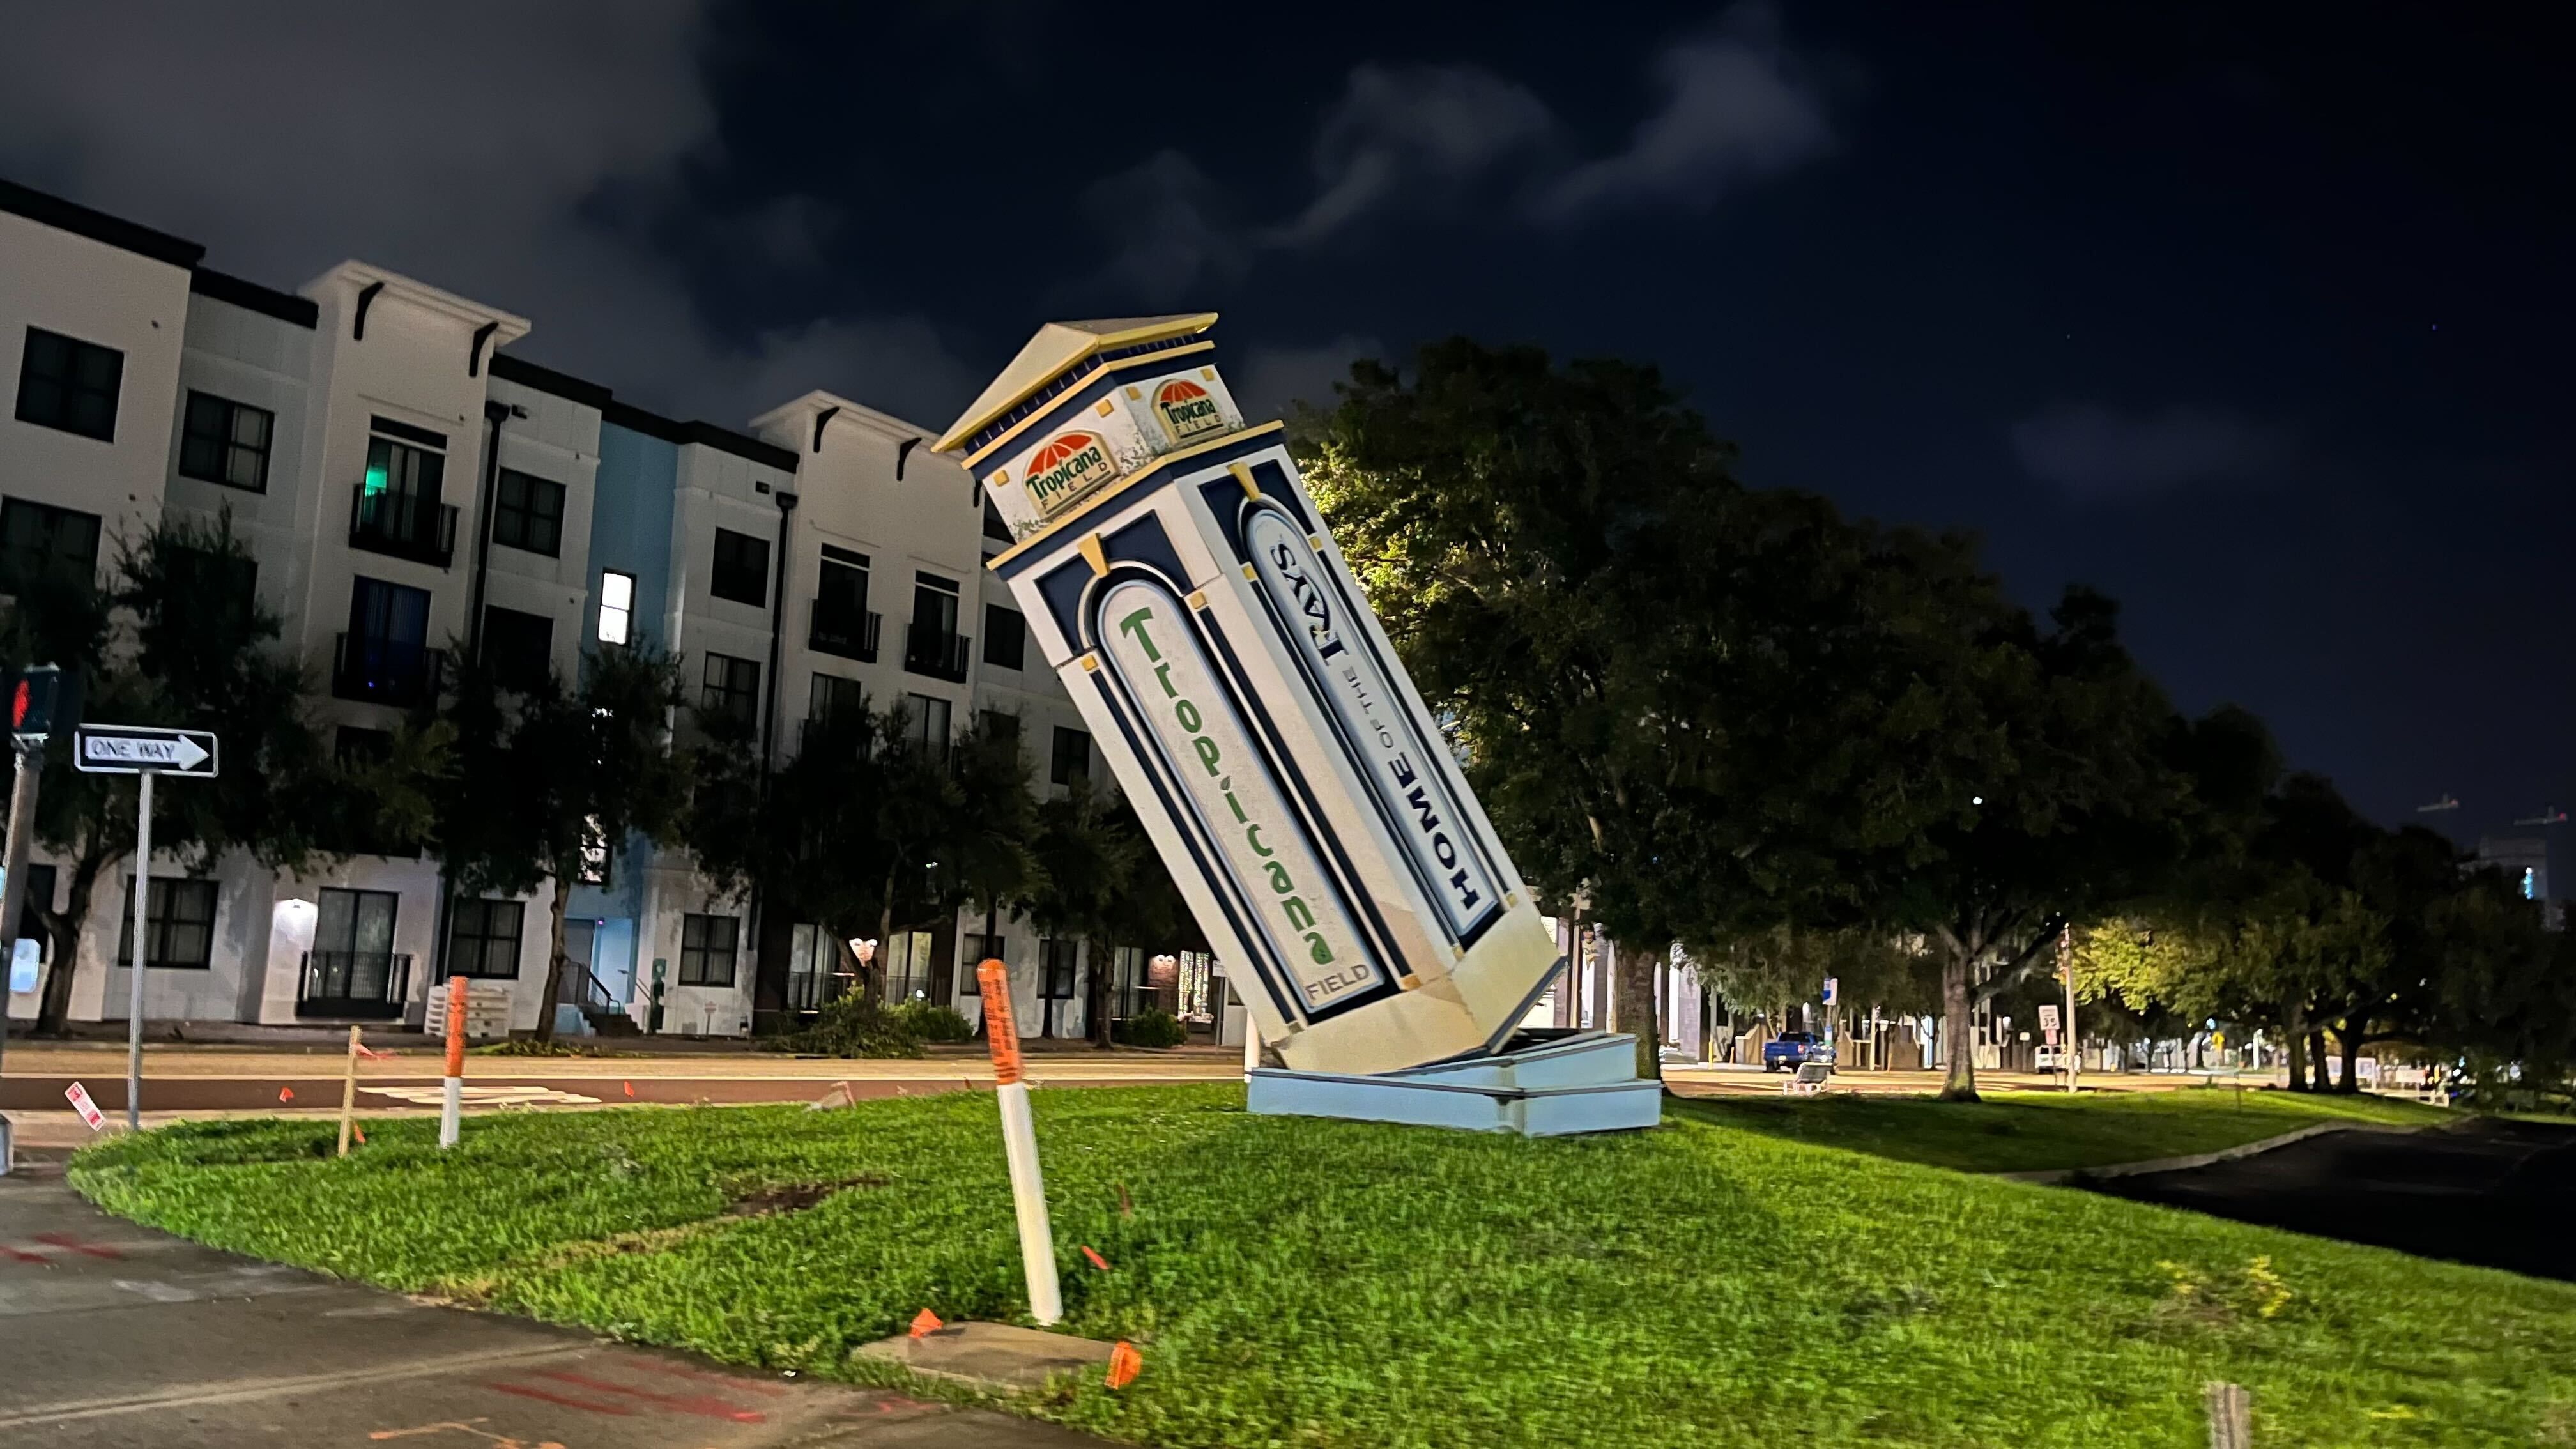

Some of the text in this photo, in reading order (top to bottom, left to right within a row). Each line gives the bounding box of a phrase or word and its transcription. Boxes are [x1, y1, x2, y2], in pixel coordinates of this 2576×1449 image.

[1160, 399, 1216, 424] Tropicana
[1175, 414, 1221, 435] FIELD
[1025, 446, 1102, 500] Tropicana
[1041, 462, 1108, 510] FIELD
[1269, 542, 1480, 911] HOME OF THE RAYS
[91, 739, 175, 760] ONE WAY
[1119, 606, 1335, 965] Tropicana
[1305, 963, 1370, 1000] FIELD
